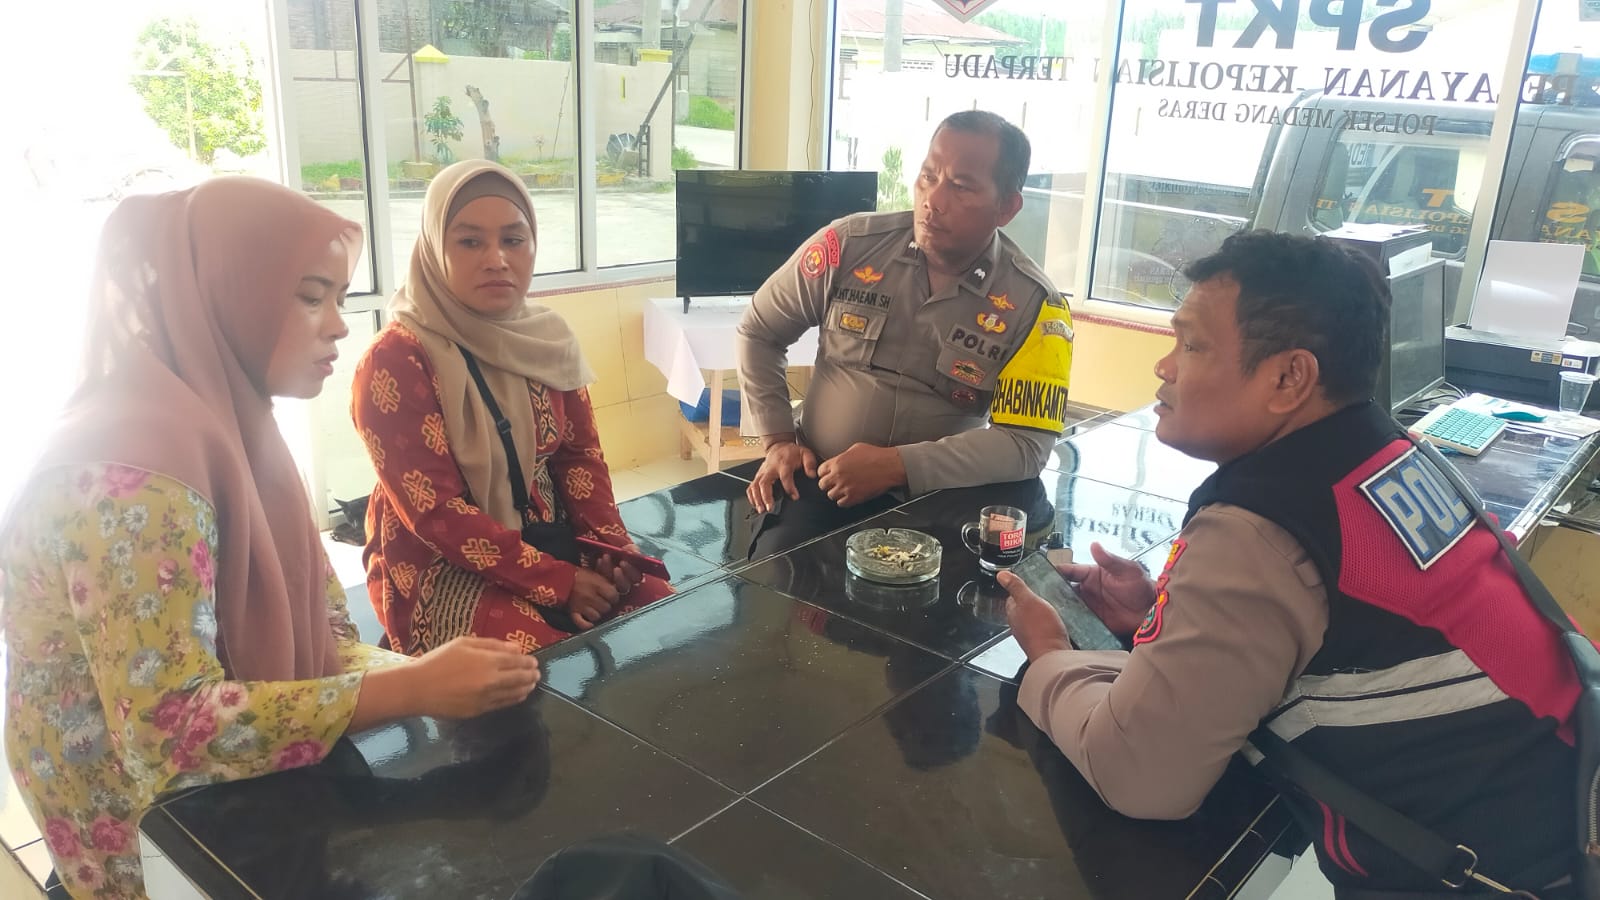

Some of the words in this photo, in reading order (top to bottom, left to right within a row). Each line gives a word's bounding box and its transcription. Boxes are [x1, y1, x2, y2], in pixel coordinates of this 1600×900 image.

[952, 327, 1008, 360] POLRI
[1003, 530, 1023, 540] TORA
[1004, 537, 1023, 547] BIKA
